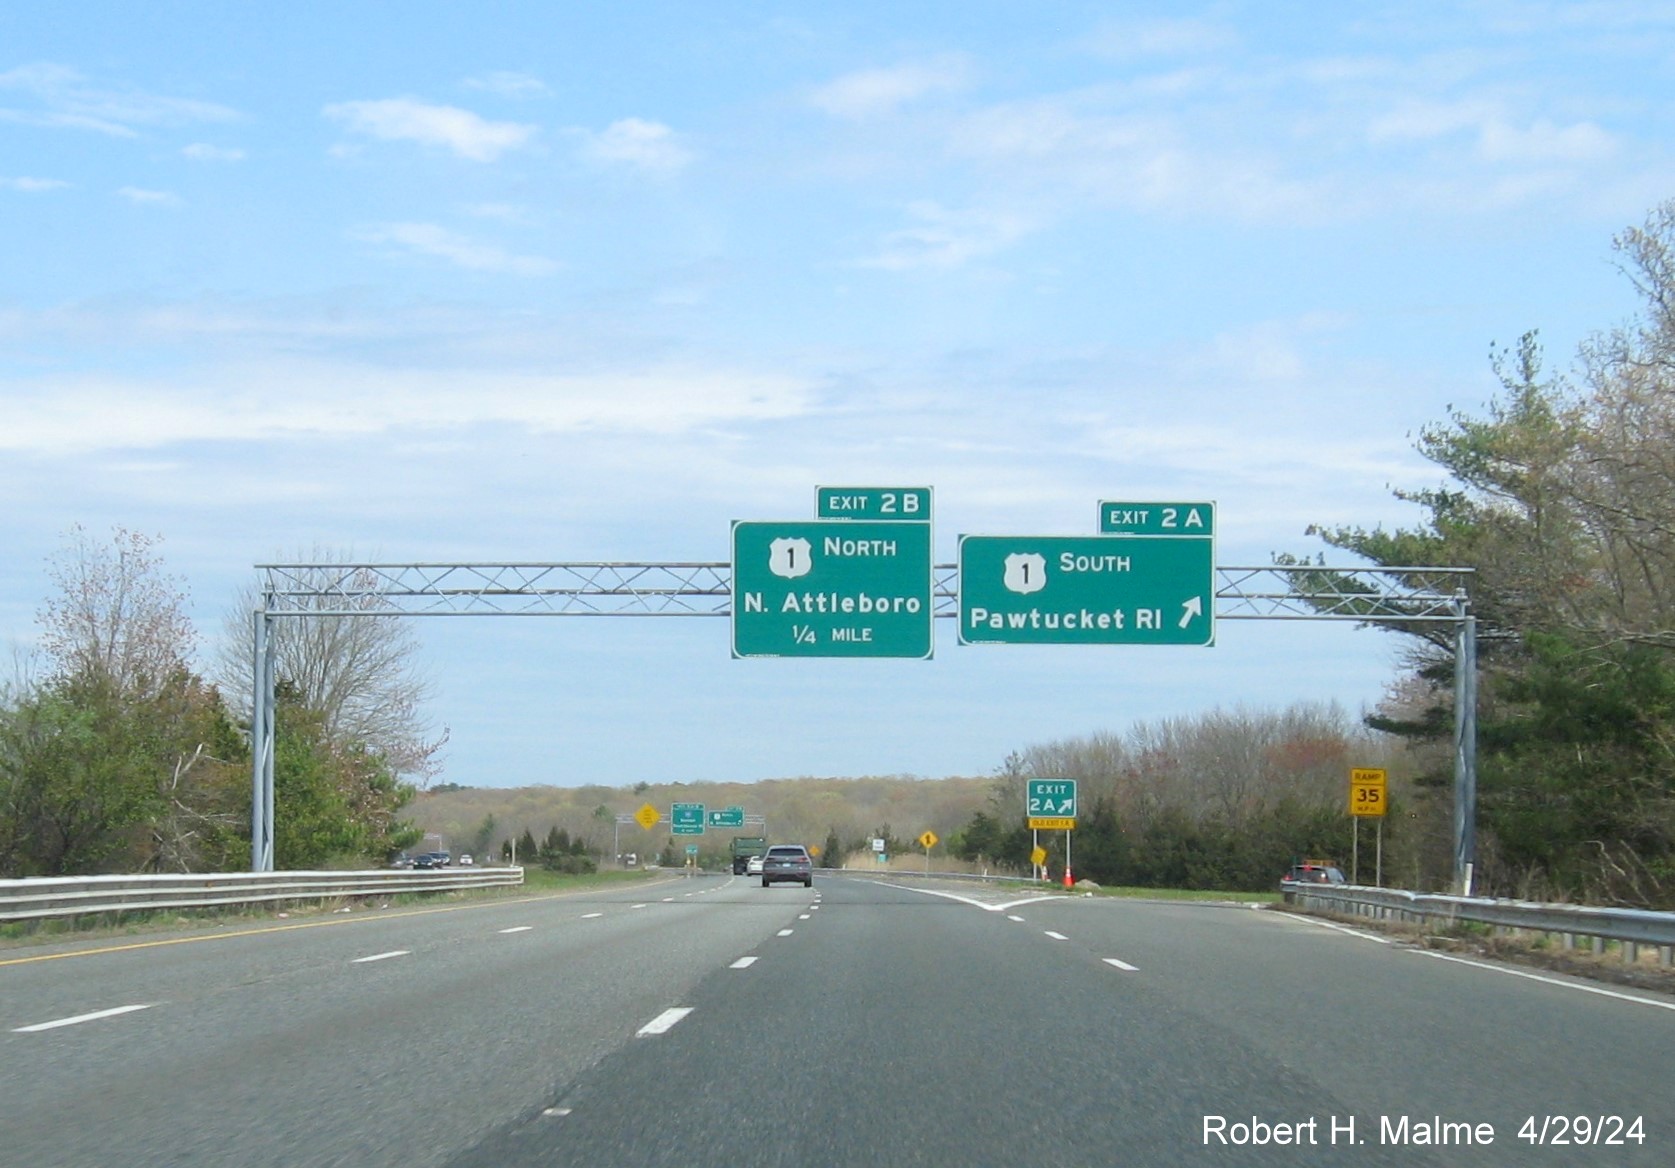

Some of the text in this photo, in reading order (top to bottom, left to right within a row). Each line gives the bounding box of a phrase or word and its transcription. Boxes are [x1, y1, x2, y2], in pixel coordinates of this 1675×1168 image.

[829, 496, 868, 509] EXIT
[1110, 510, 1149, 524] EXIT
[786, 537, 897, 569] 1 NORTH
[1021, 552, 1130, 584] 1 SOUTH
[744, 591, 921, 614] N. Attleboro
[970, 607, 1161, 629] Pawtucket RI
[831, 628, 873, 642] MILE
[1355, 772, 1382, 780] RAMP
[1037, 784, 1067, 794] EXIT
[1357, 788, 1379, 802] 35
[1030, 798, 1056, 811] 2A
